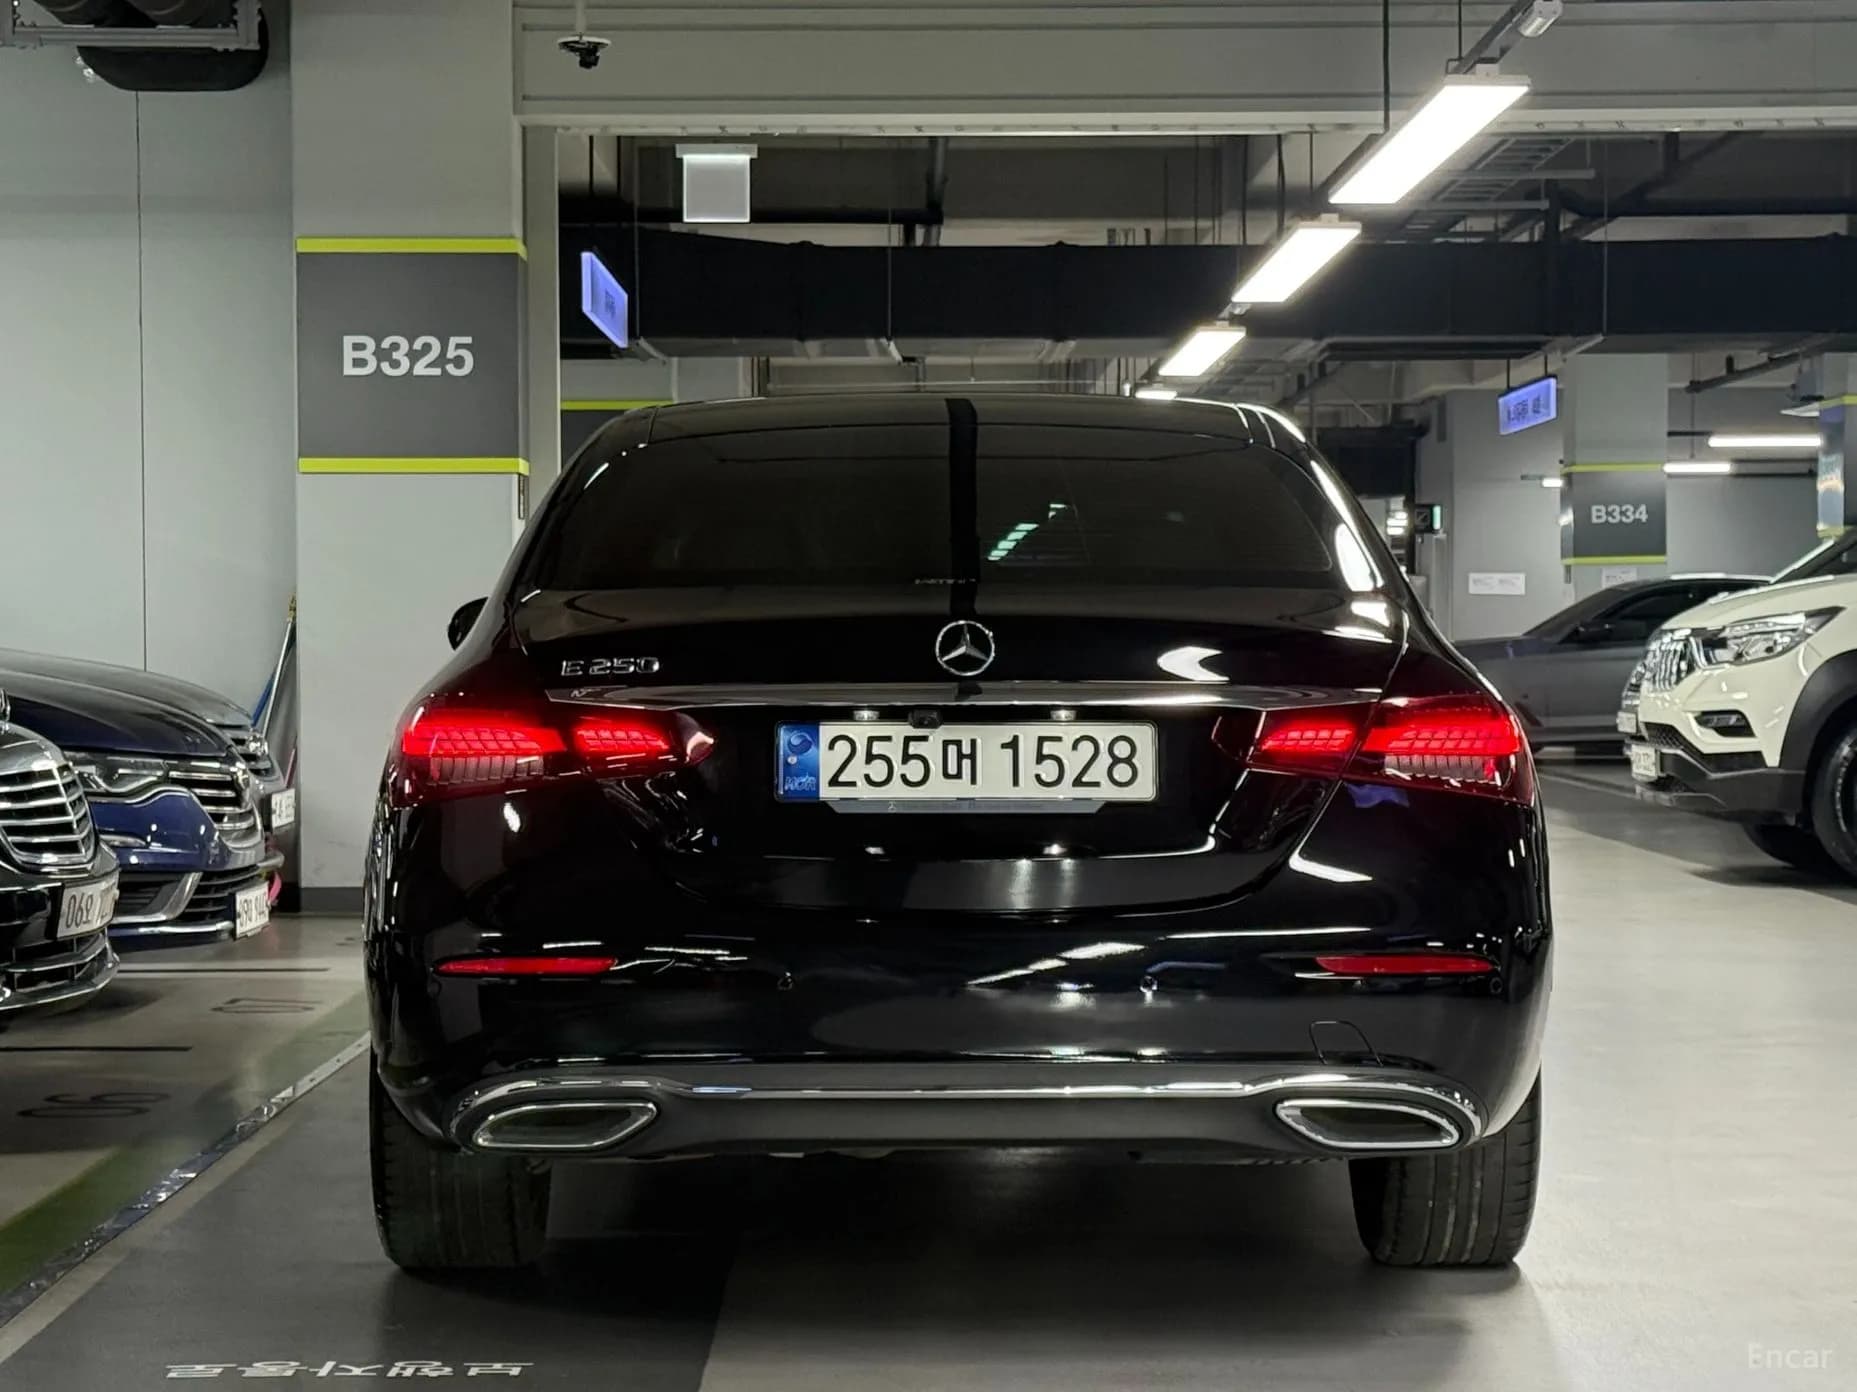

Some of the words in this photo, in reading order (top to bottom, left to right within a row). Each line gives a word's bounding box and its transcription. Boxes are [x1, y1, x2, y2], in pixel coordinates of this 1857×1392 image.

[343, 335, 474, 376] B325
[1591, 504, 1649, 524] B334
[561, 660, 585, 676] E
[589, 656, 660, 675] 250
[827, 735, 978, 788] 255머
[1000, 735, 1138, 788] 1528
[165, 1360, 535, 1378] 보행자통로
